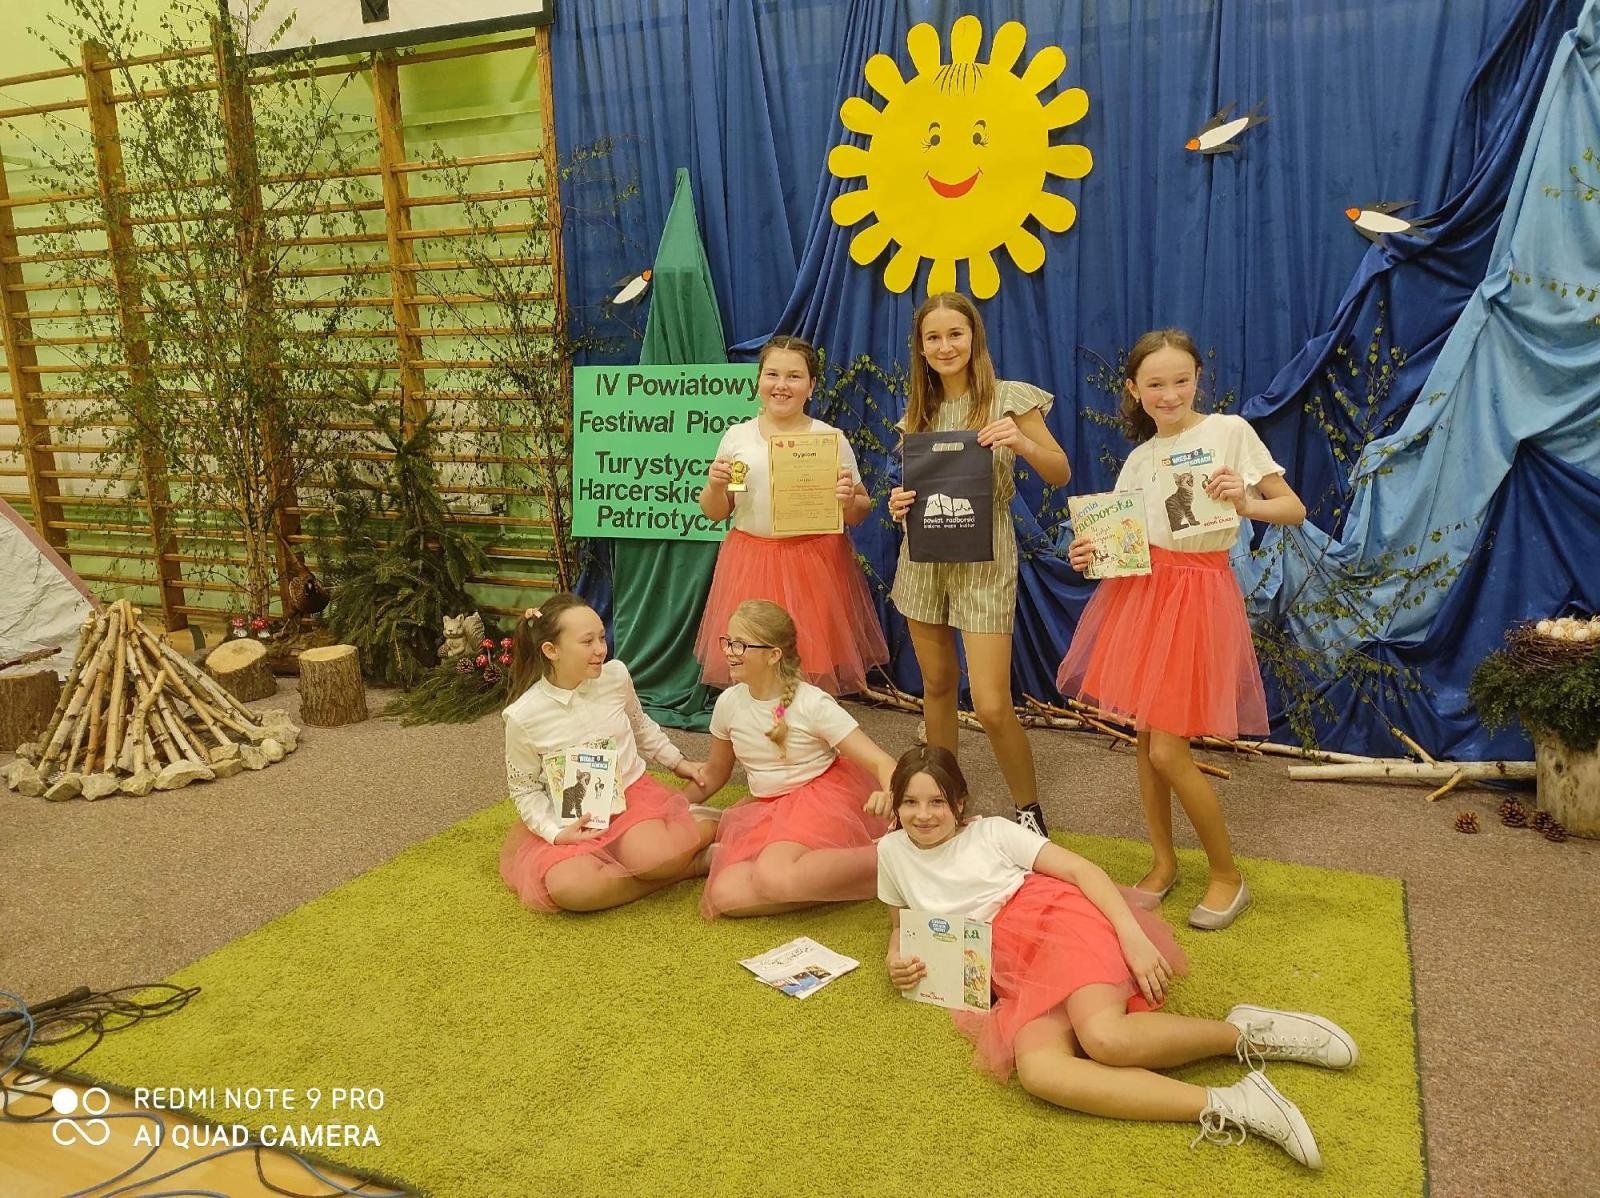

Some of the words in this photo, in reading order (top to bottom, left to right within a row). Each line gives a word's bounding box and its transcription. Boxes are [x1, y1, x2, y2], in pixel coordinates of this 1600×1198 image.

[596, 372, 621, 396] IV
[627, 371, 759, 401] Powiatowy
[579, 410, 675, 433] Festiwal
